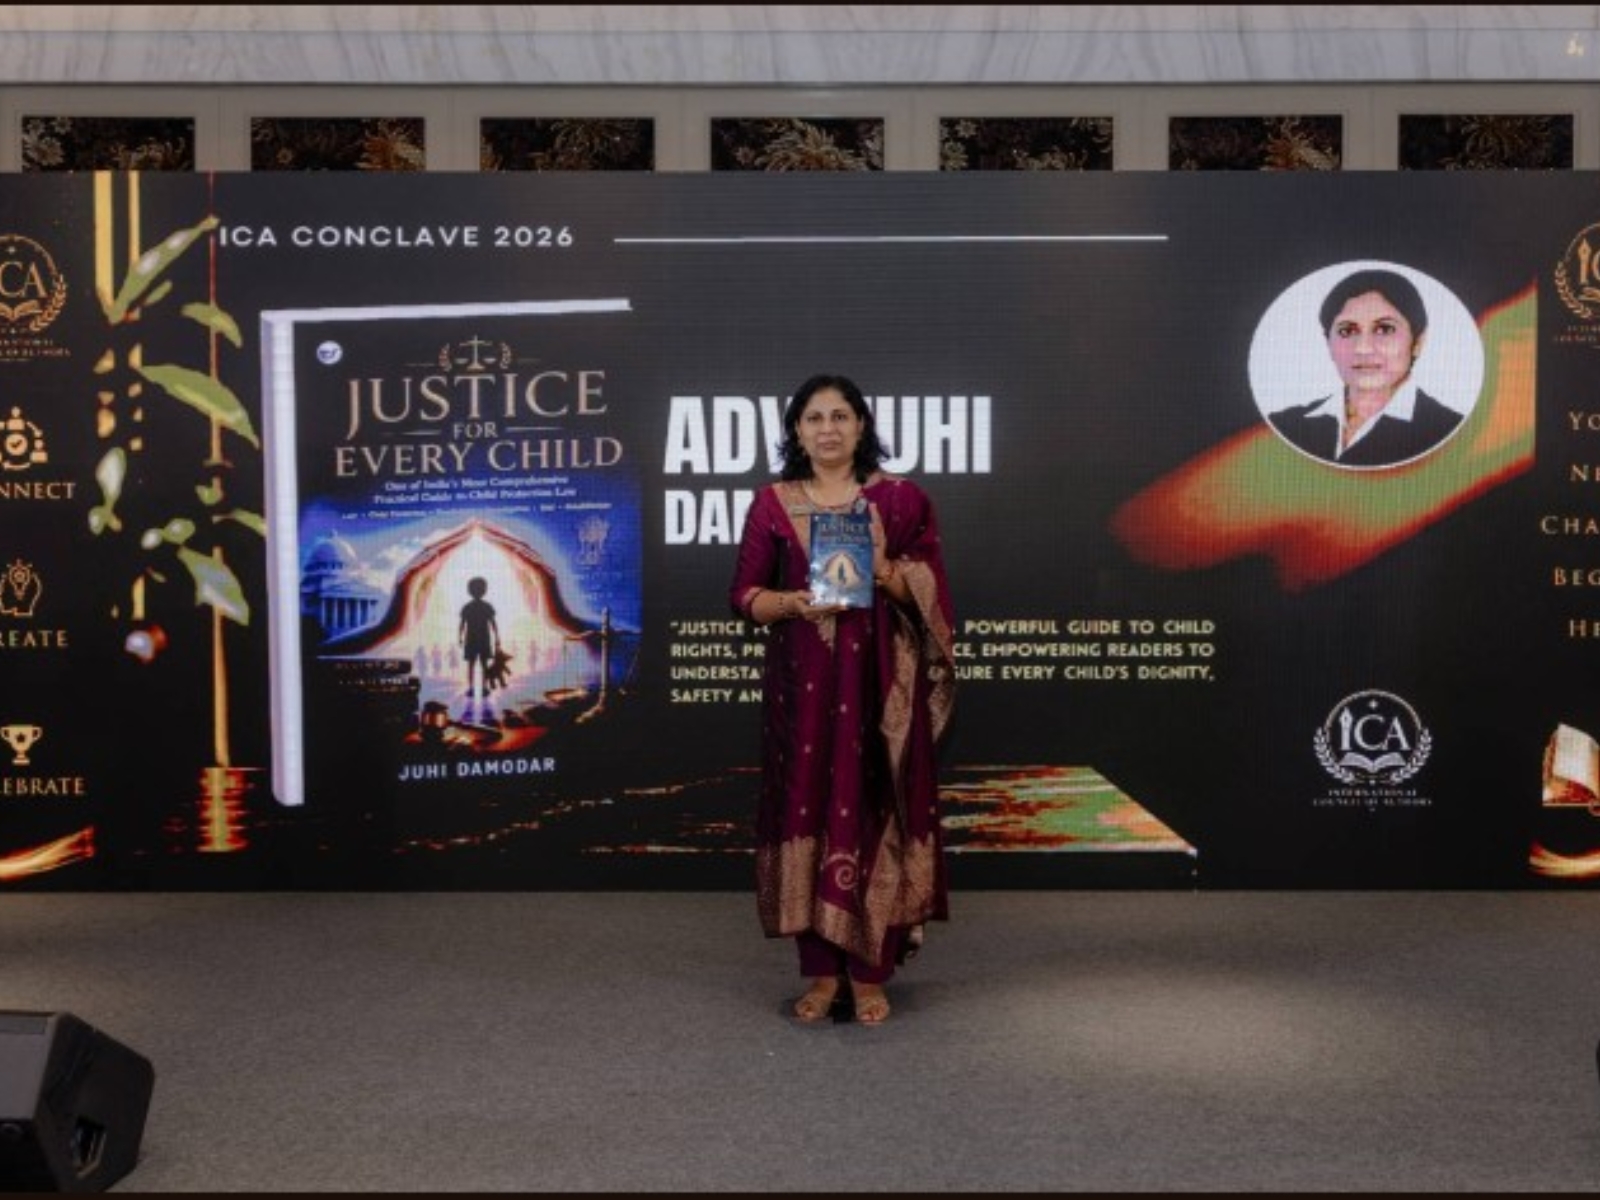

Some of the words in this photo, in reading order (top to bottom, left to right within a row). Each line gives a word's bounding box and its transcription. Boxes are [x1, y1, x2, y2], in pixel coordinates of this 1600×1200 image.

[220, 226, 277, 246] ICA
[291, 226, 478, 246] CONCLAVE
[494, 226, 574, 246] 2026
[346, 370, 607, 440] JUSTICE
[453, 421, 498, 439] FOR
[868, 396, 992, 475] UHI
[336, 442, 472, 477] EVERY
[487, 436, 623, 472] CHILD
[964, 619, 1059, 634] POWERFUL
[1067, 619, 1121, 634] GUIDE
[1129, 619, 1155, 634] TO
[1163, 619, 1215, 634] CHILD
[670, 643, 737, 659] RIGHTS,
[982, 643, 1101, 658] EMPOWERING
[1107, 643, 1183, 658] READERS
[1189, 643, 1215, 658] TO
[670, 665, 763, 681] UNDERSTA
[1002, 665, 1056, 680] EVERY
[1064, 665, 1129, 680] CHILD'S
[1137, 665, 1215, 682] DIGNITY,
[670, 688, 733, 703] SAFETY
[1339, 706, 1411, 751] ICA
[398, 764, 448, 781] JUHI
[456, 757, 555, 777] DAMODAR
[0, 777, 84, 795] EBRATE
